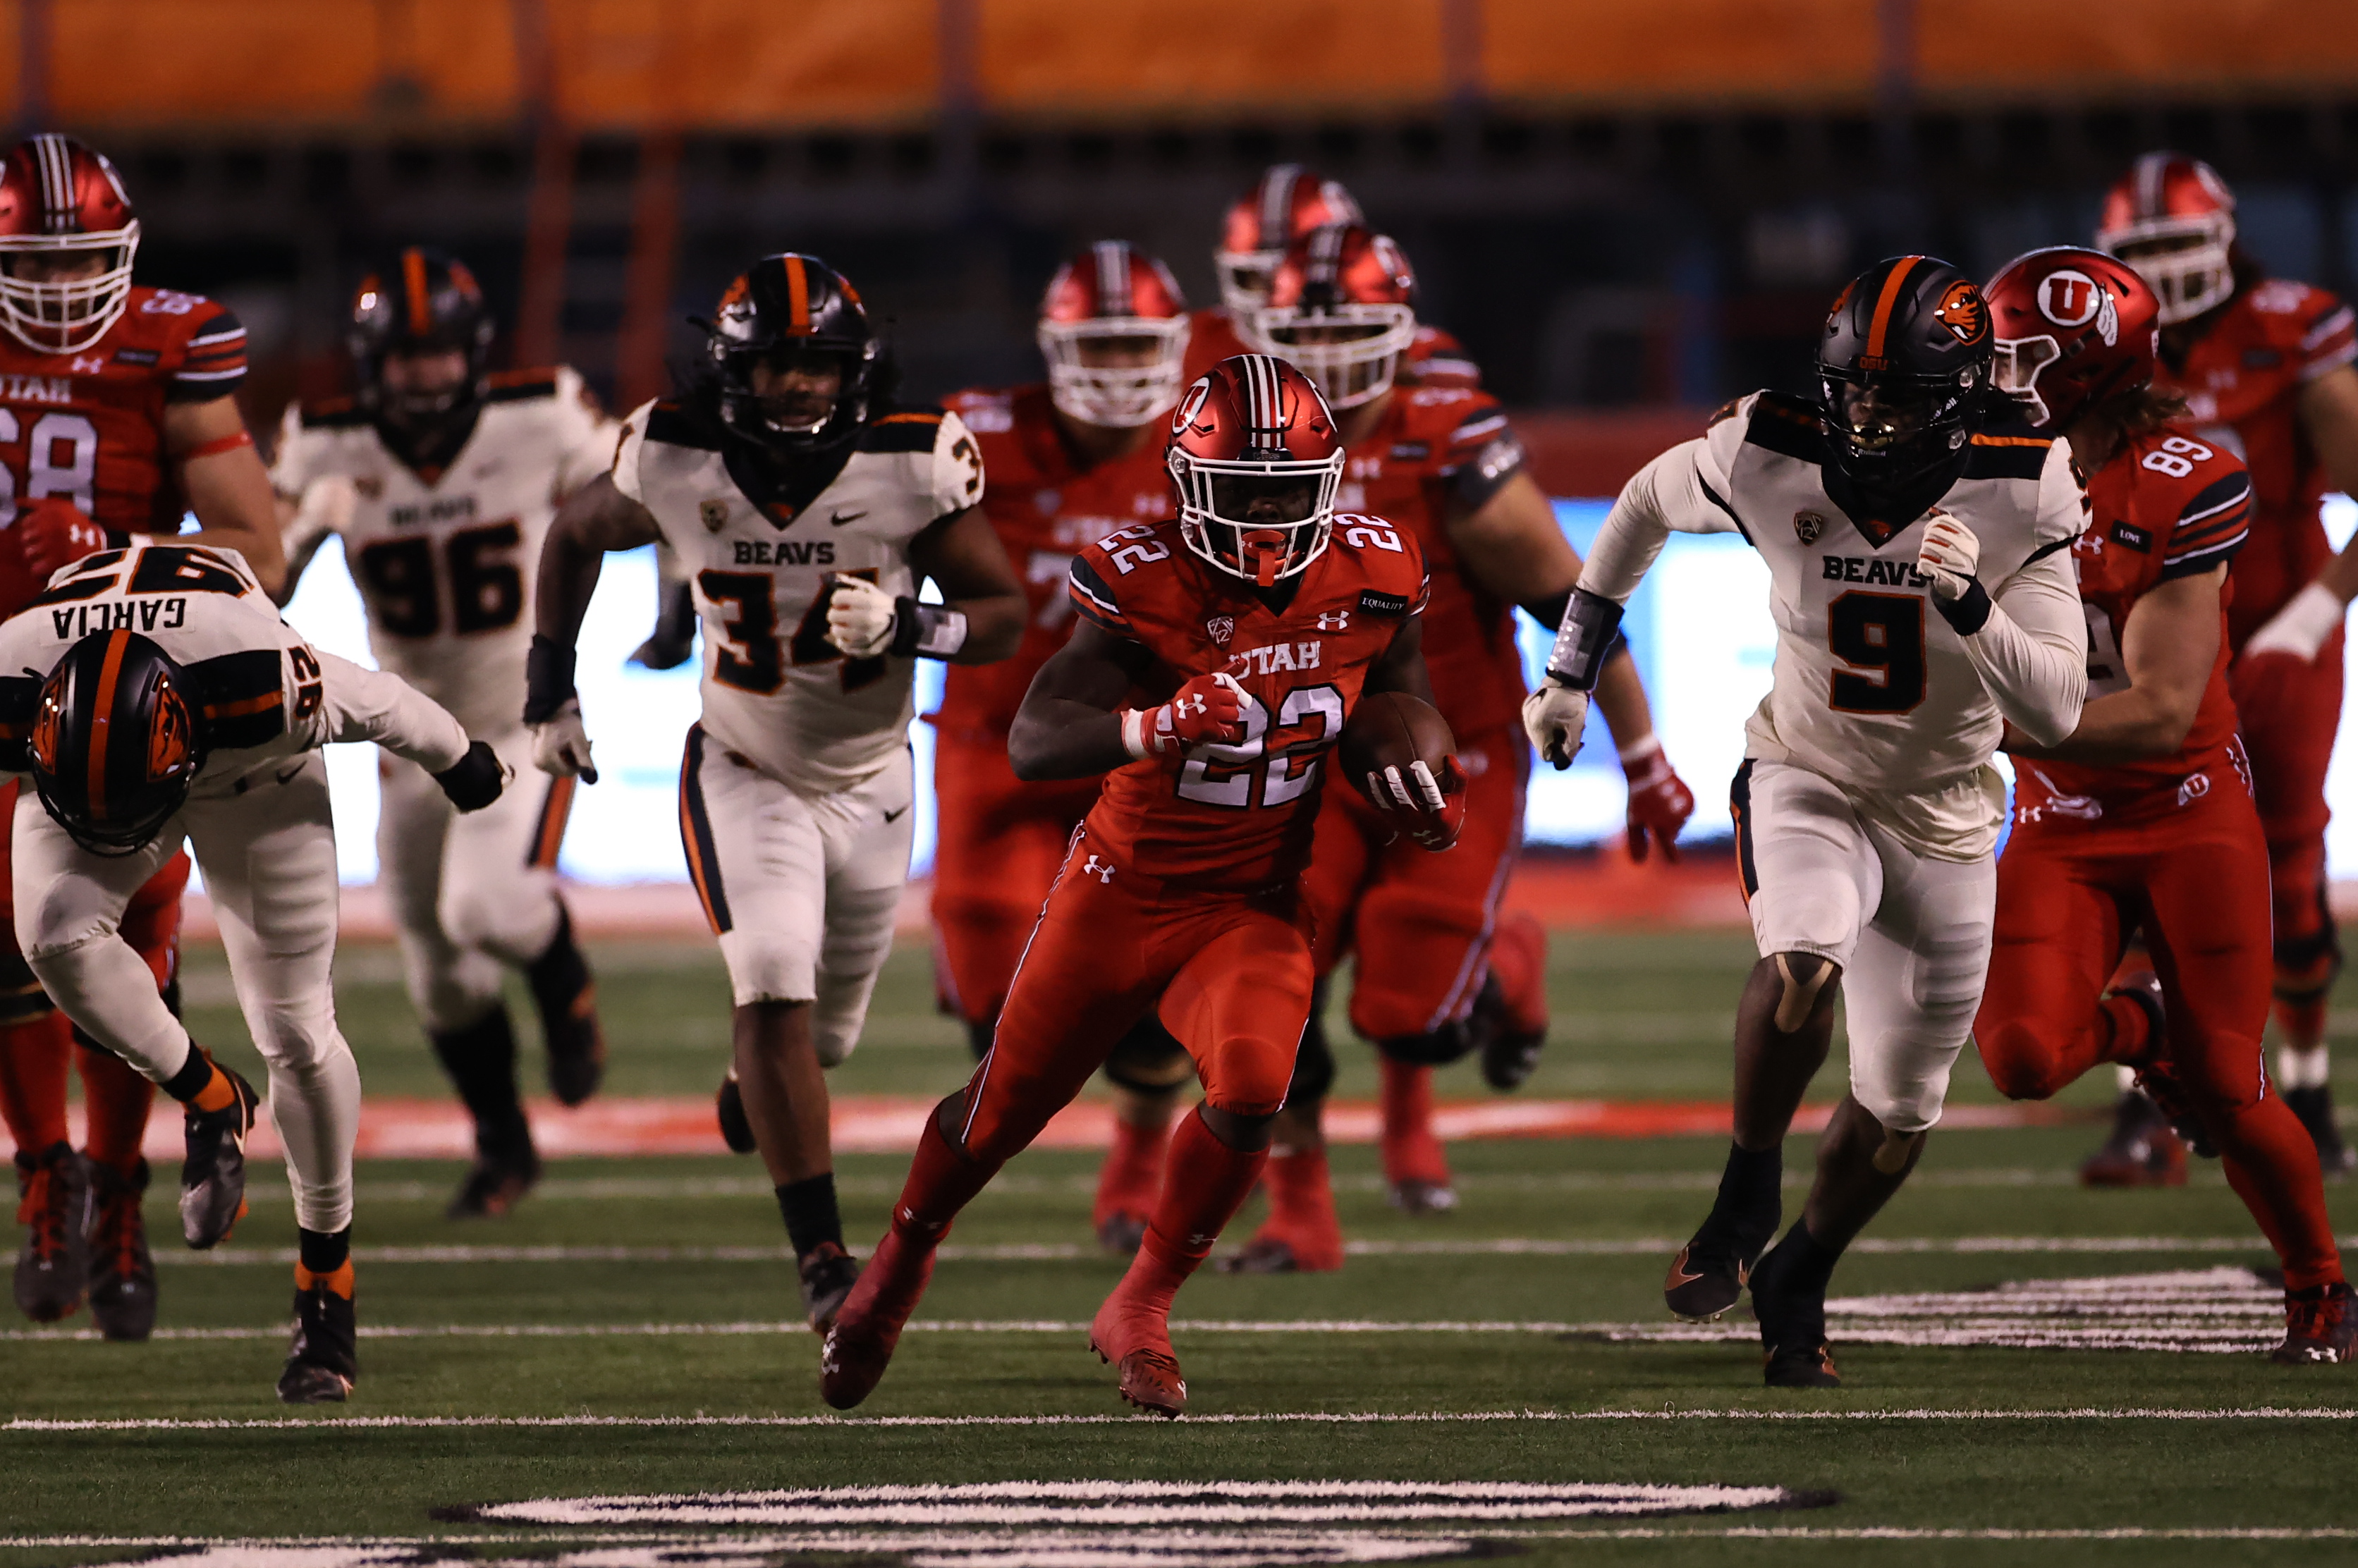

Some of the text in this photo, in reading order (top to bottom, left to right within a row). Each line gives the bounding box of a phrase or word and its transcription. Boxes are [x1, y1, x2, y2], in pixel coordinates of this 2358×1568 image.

[2048, 278, 2092, 321] U
[0, 374, 71, 404] TAH
[2142, 436, 2214, 478] 89
[733, 540, 836, 564] BEAVS
[1823, 556, 1928, 588] BEAVS
[361, 520, 523, 637] 96
[52, 599, 186, 639] GARCIA
[1362, 596, 1405, 611] EQUALITY
[697, 567, 887, 697] 34
[1215, 629, 1230, 644] 12
[1228, 640, 1321, 680] UTAH
[1828, 589, 1928, 716] 9
[1175, 684, 1345, 809] 22
